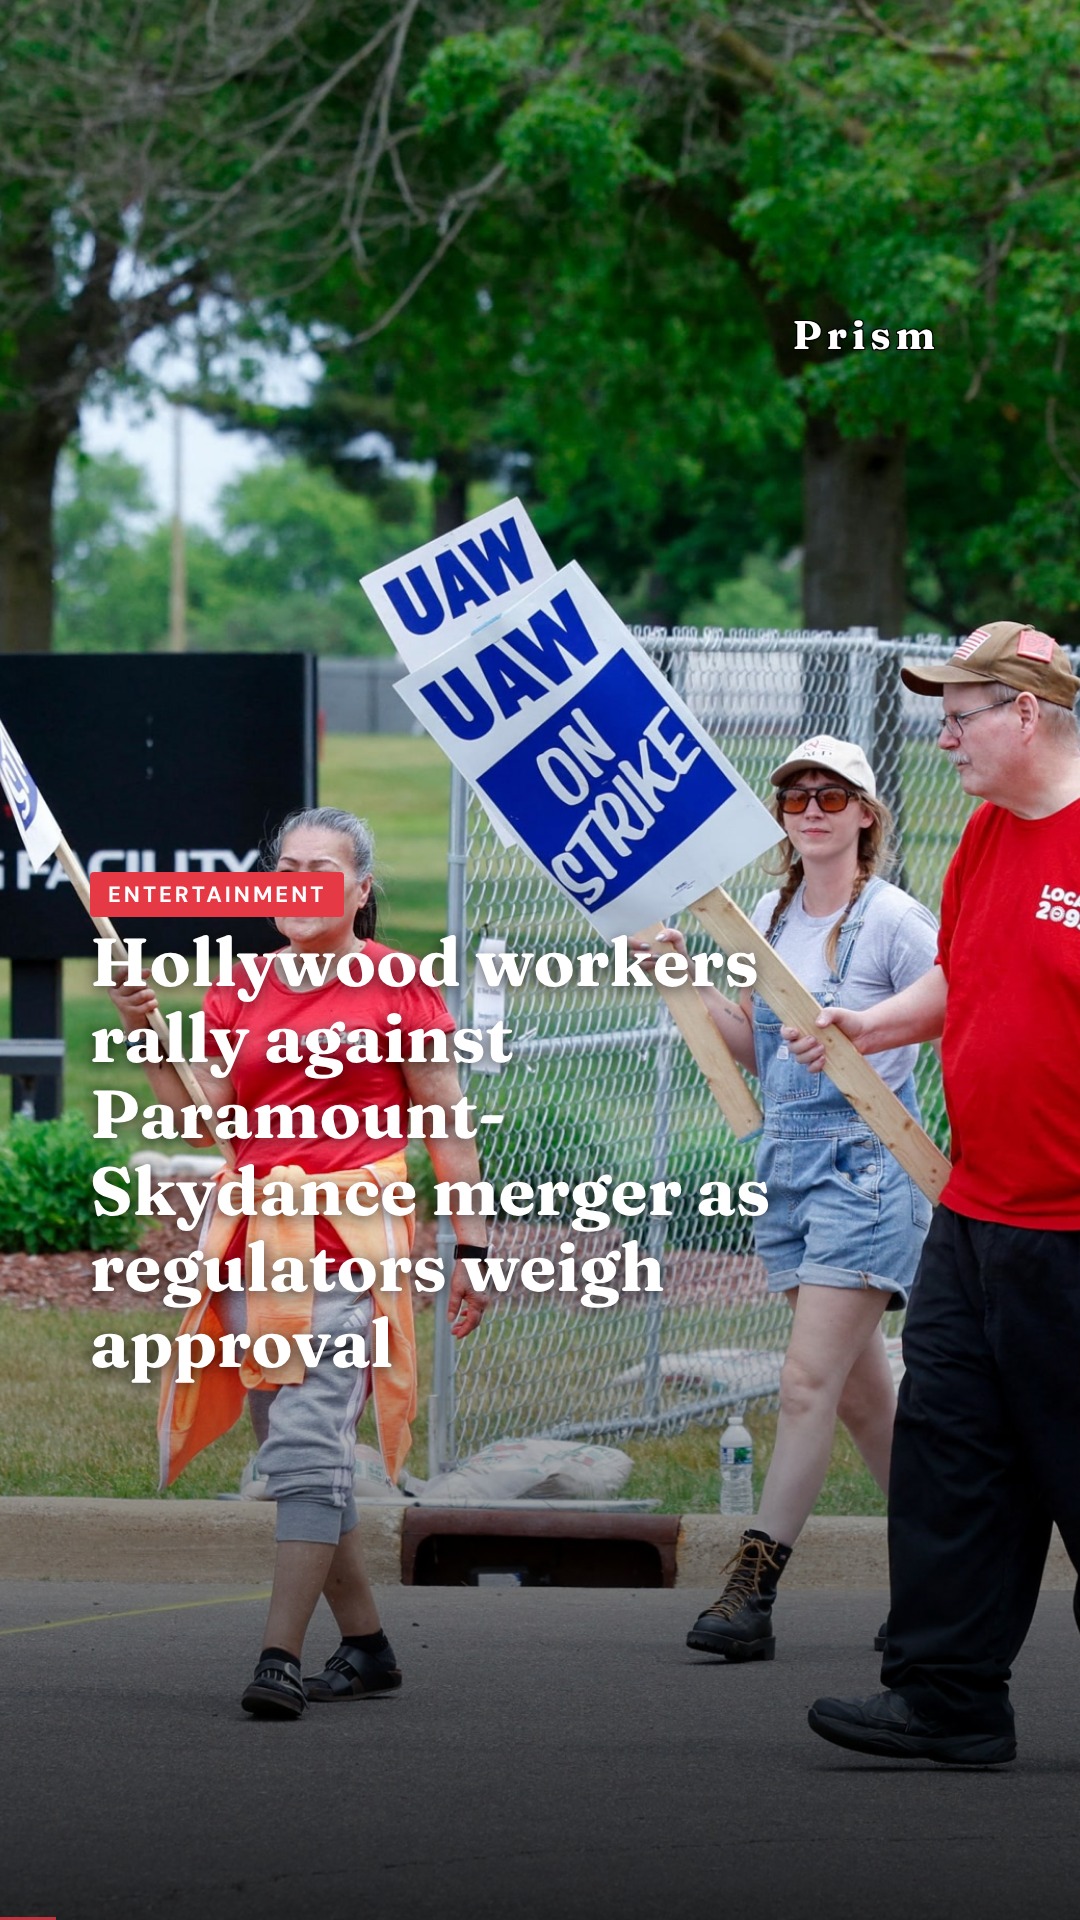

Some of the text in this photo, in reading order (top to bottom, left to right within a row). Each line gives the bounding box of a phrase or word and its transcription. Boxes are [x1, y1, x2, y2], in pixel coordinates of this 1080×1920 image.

[383, 516, 534, 636] UAW
[419, 588, 600, 741] UAW
[536, 707, 616, 806] ON
[551, 705, 702, 906] STRIKE
[1035, 900, 1080, 930] 209
